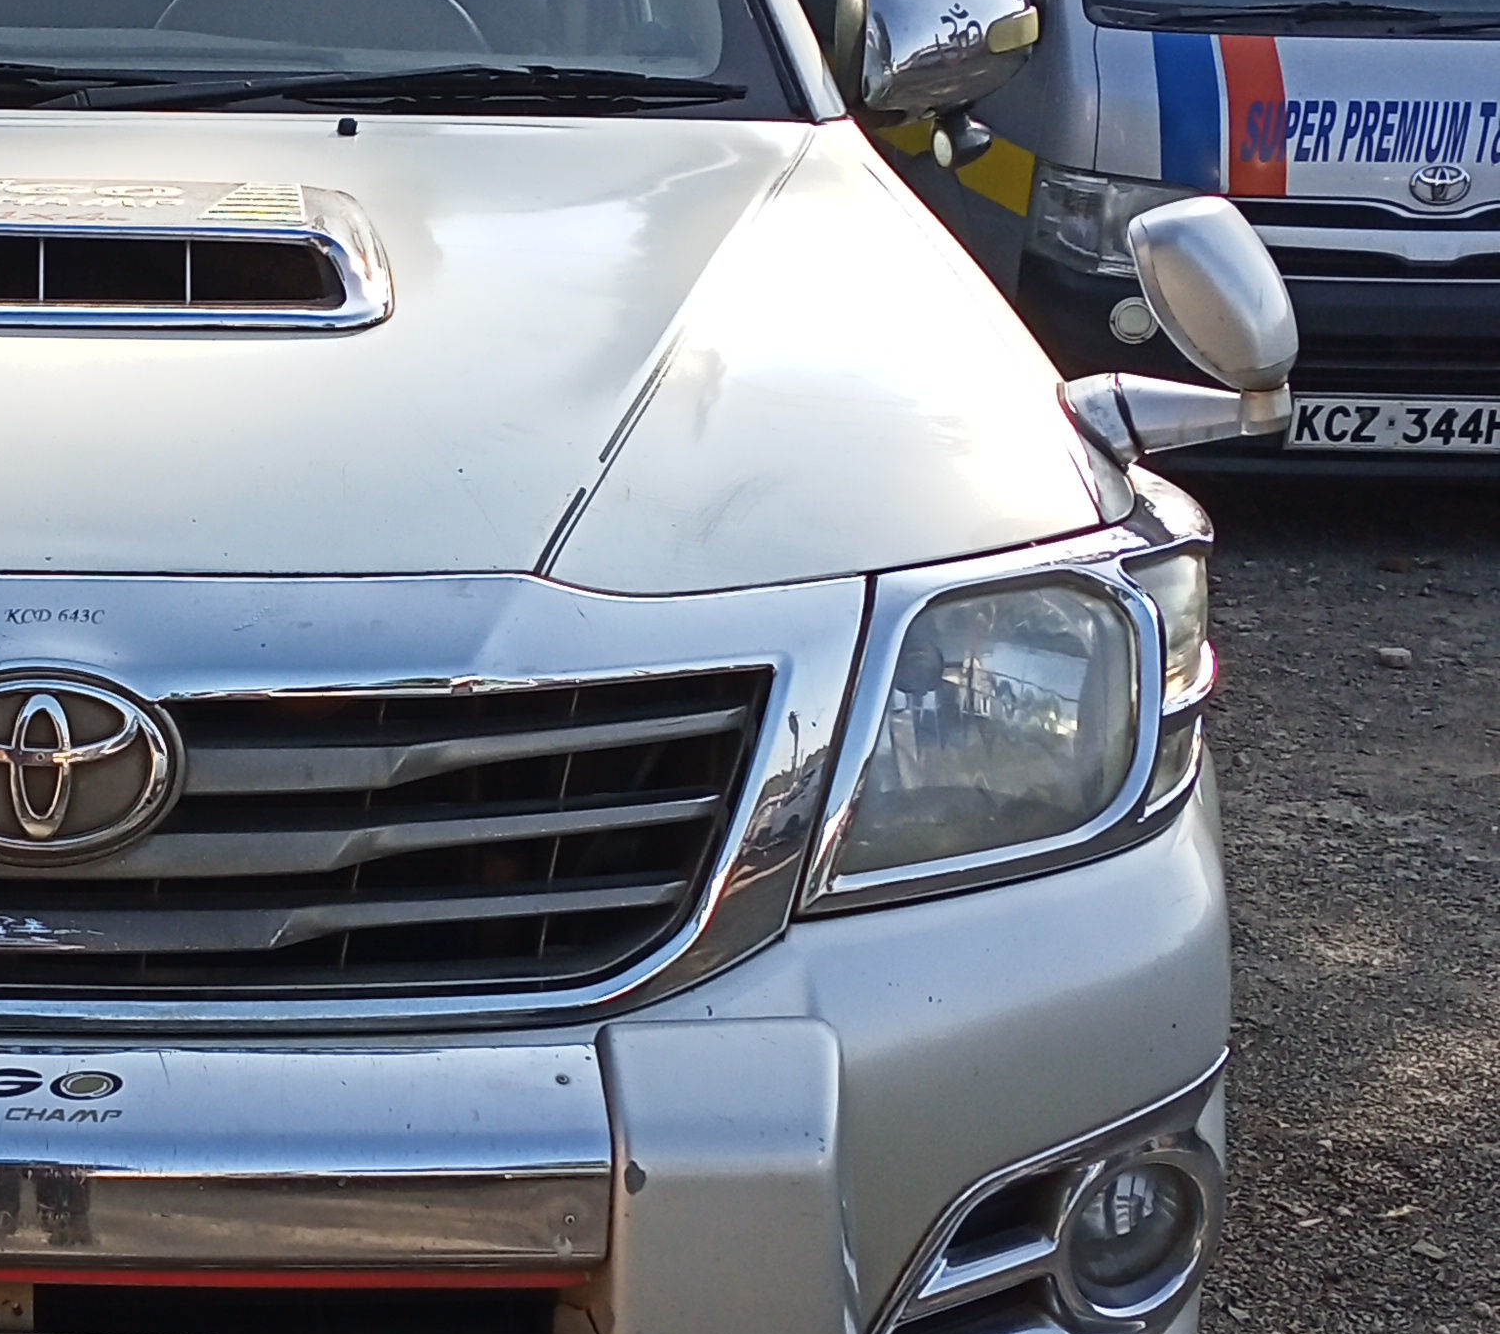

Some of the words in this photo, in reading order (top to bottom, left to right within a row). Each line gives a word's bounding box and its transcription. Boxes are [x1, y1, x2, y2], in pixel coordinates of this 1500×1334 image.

[1241, 100, 1337, 163] SUPER
[1338, 100, 1472, 163] PREMIUM
[1294, 405, 1381, 443] KCZ
[4, 608, 52, 625] KCD
[58, 608, 105, 625] 643C
[5, 1107, 122, 1124] CHAMP
